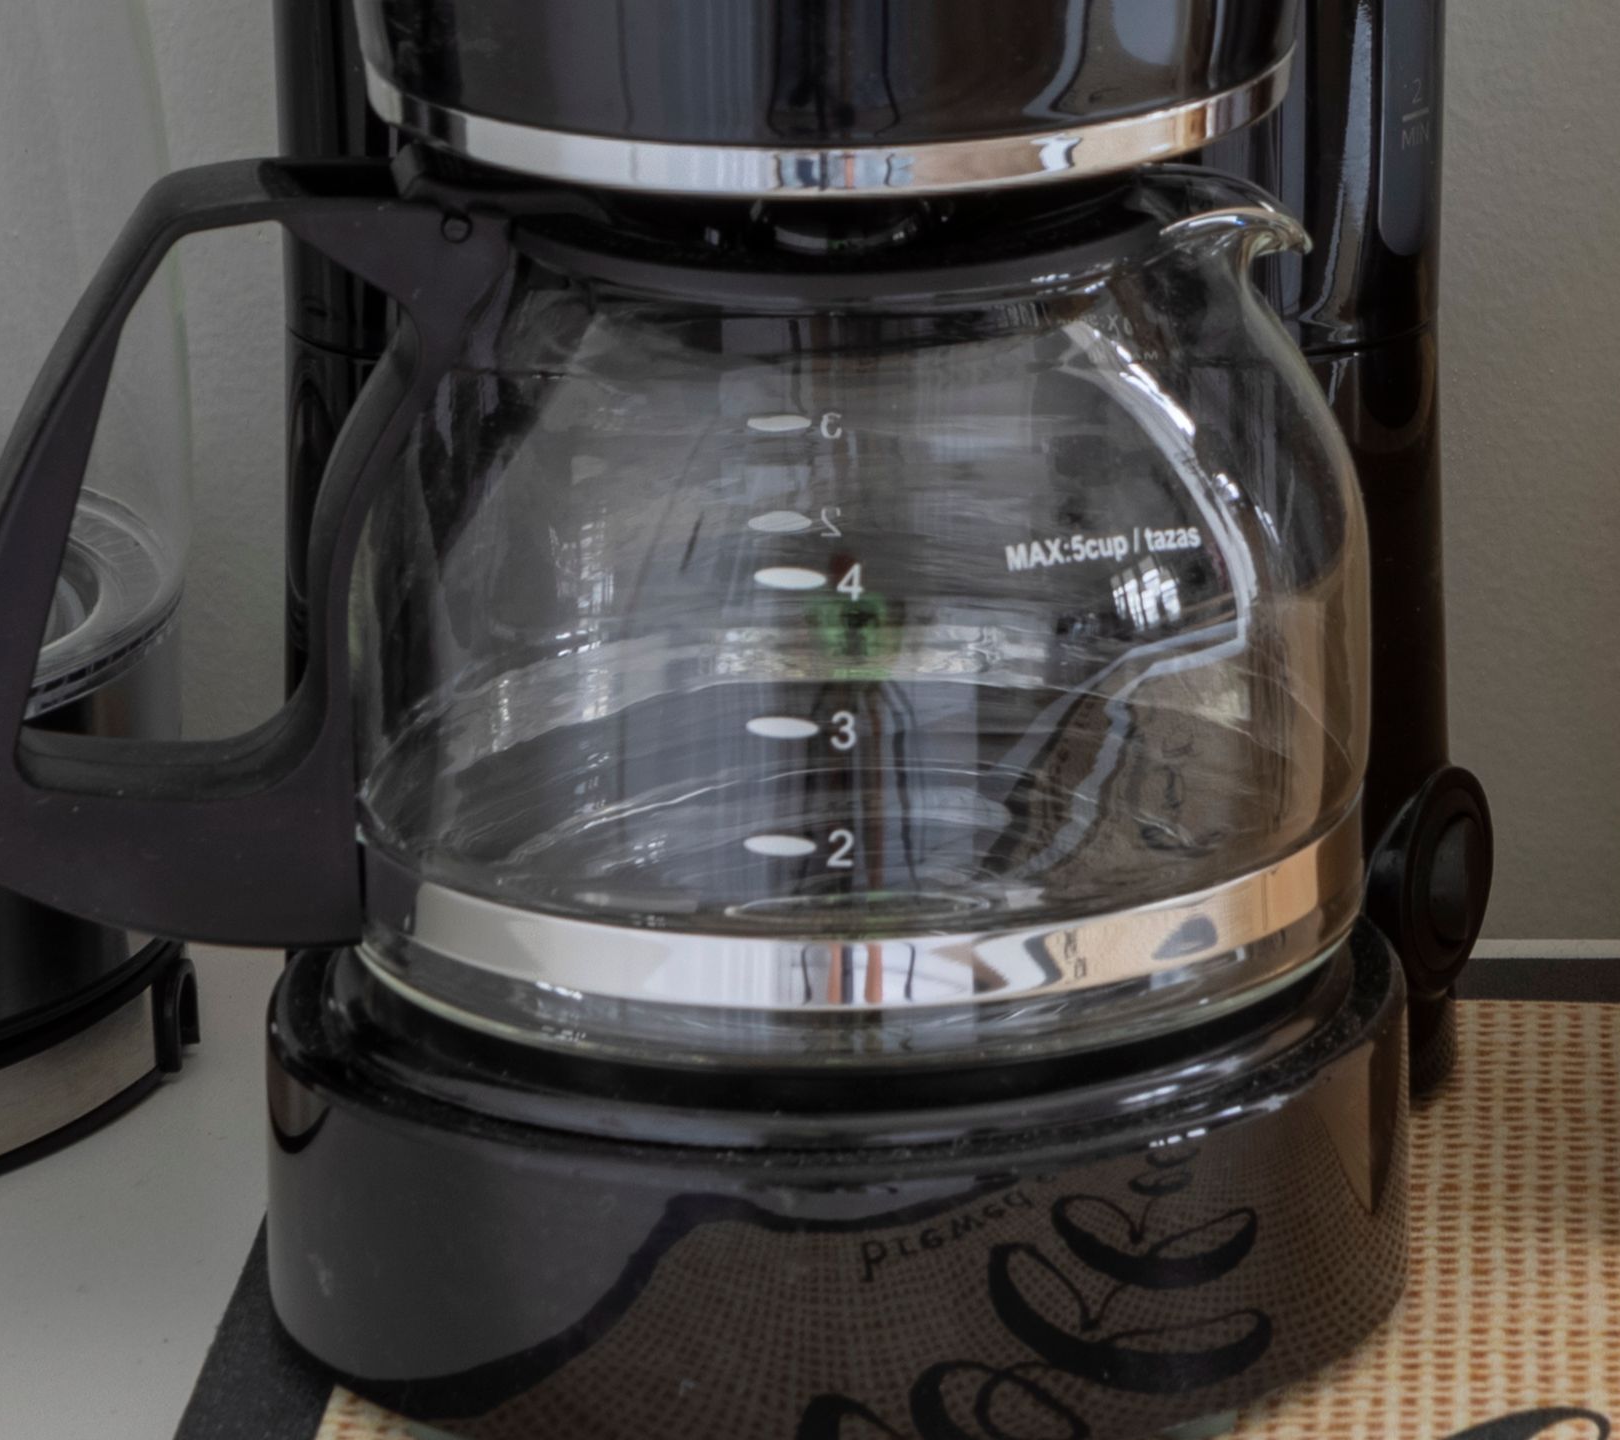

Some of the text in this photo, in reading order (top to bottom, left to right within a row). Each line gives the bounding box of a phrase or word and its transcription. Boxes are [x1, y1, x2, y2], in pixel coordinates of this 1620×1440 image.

[1411, 77, 1423, 105] 2
[1400, 122, 1431, 151] MIN
[1004, 533, 1130, 572] MAX:5cup
[1144, 525, 1203, 554] tazas
[836, 562, 864, 602] 4
[830, 709, 857, 751] 3
[826, 828, 855, 868] 2
